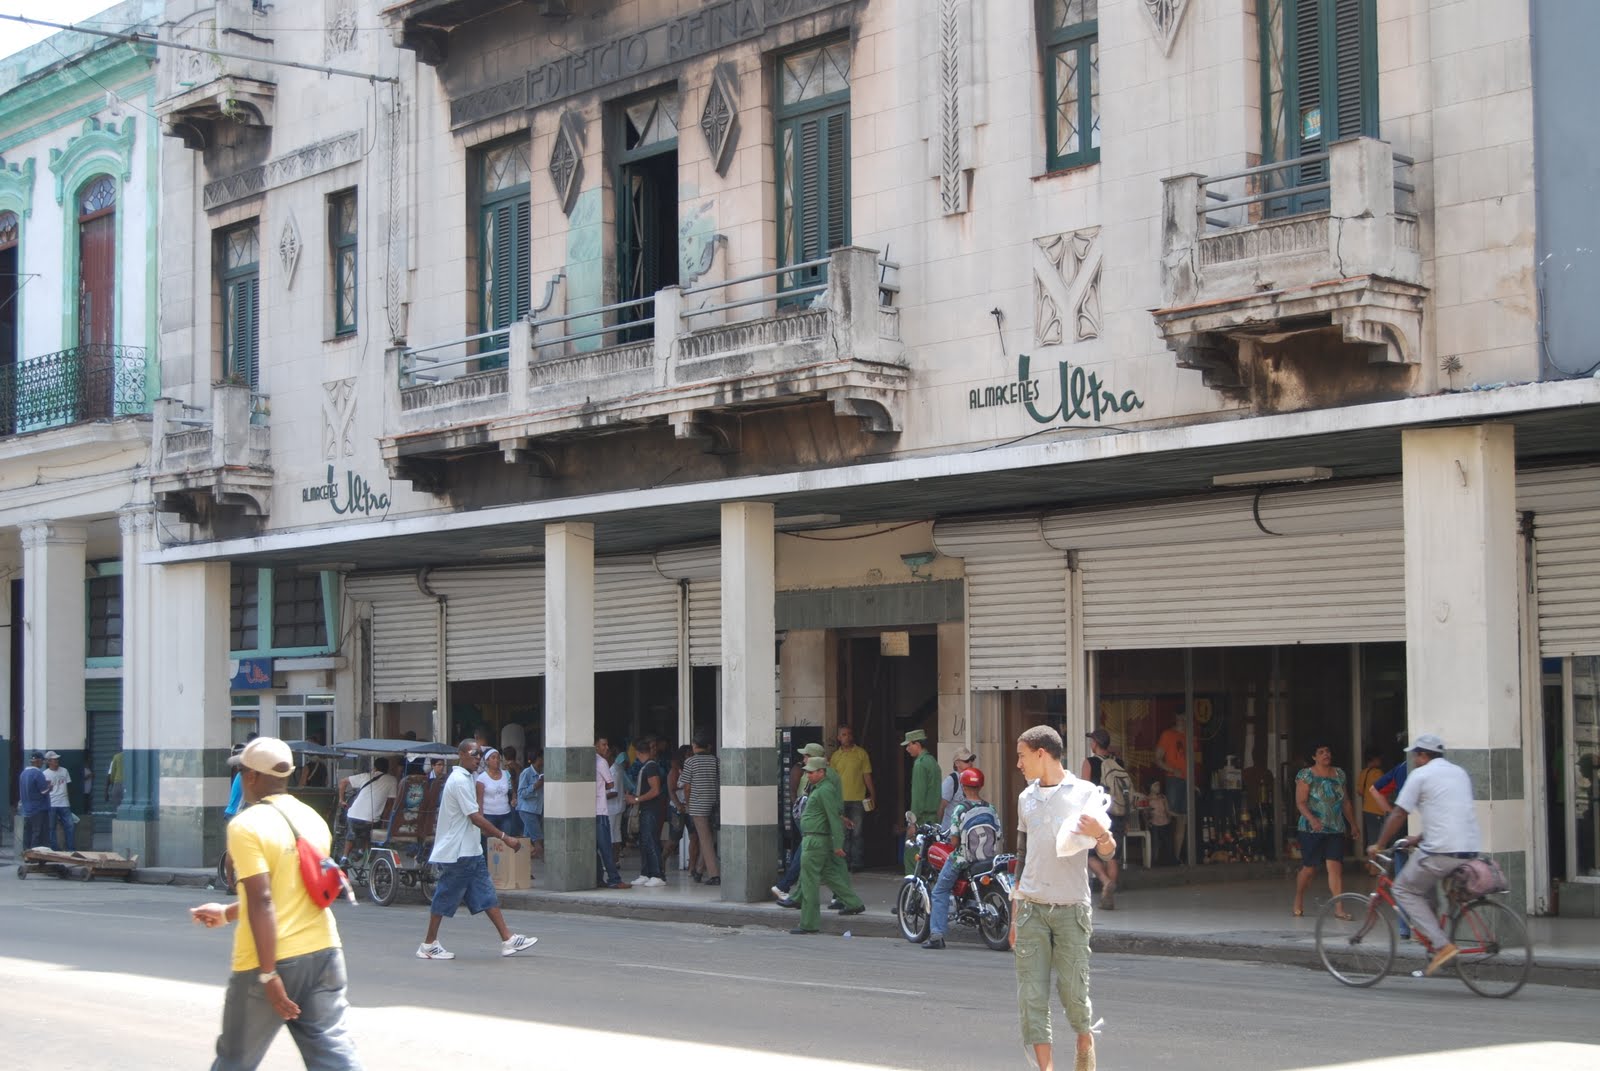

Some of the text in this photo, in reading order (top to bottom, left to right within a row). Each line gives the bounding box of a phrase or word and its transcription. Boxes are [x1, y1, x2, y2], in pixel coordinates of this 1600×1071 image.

[526, 0, 765, 105] EDIFICIO REINA
[969, 354, 1145, 424] ALMACENES Ultra
[302, 464, 391, 516] ALMACENES Ultra
